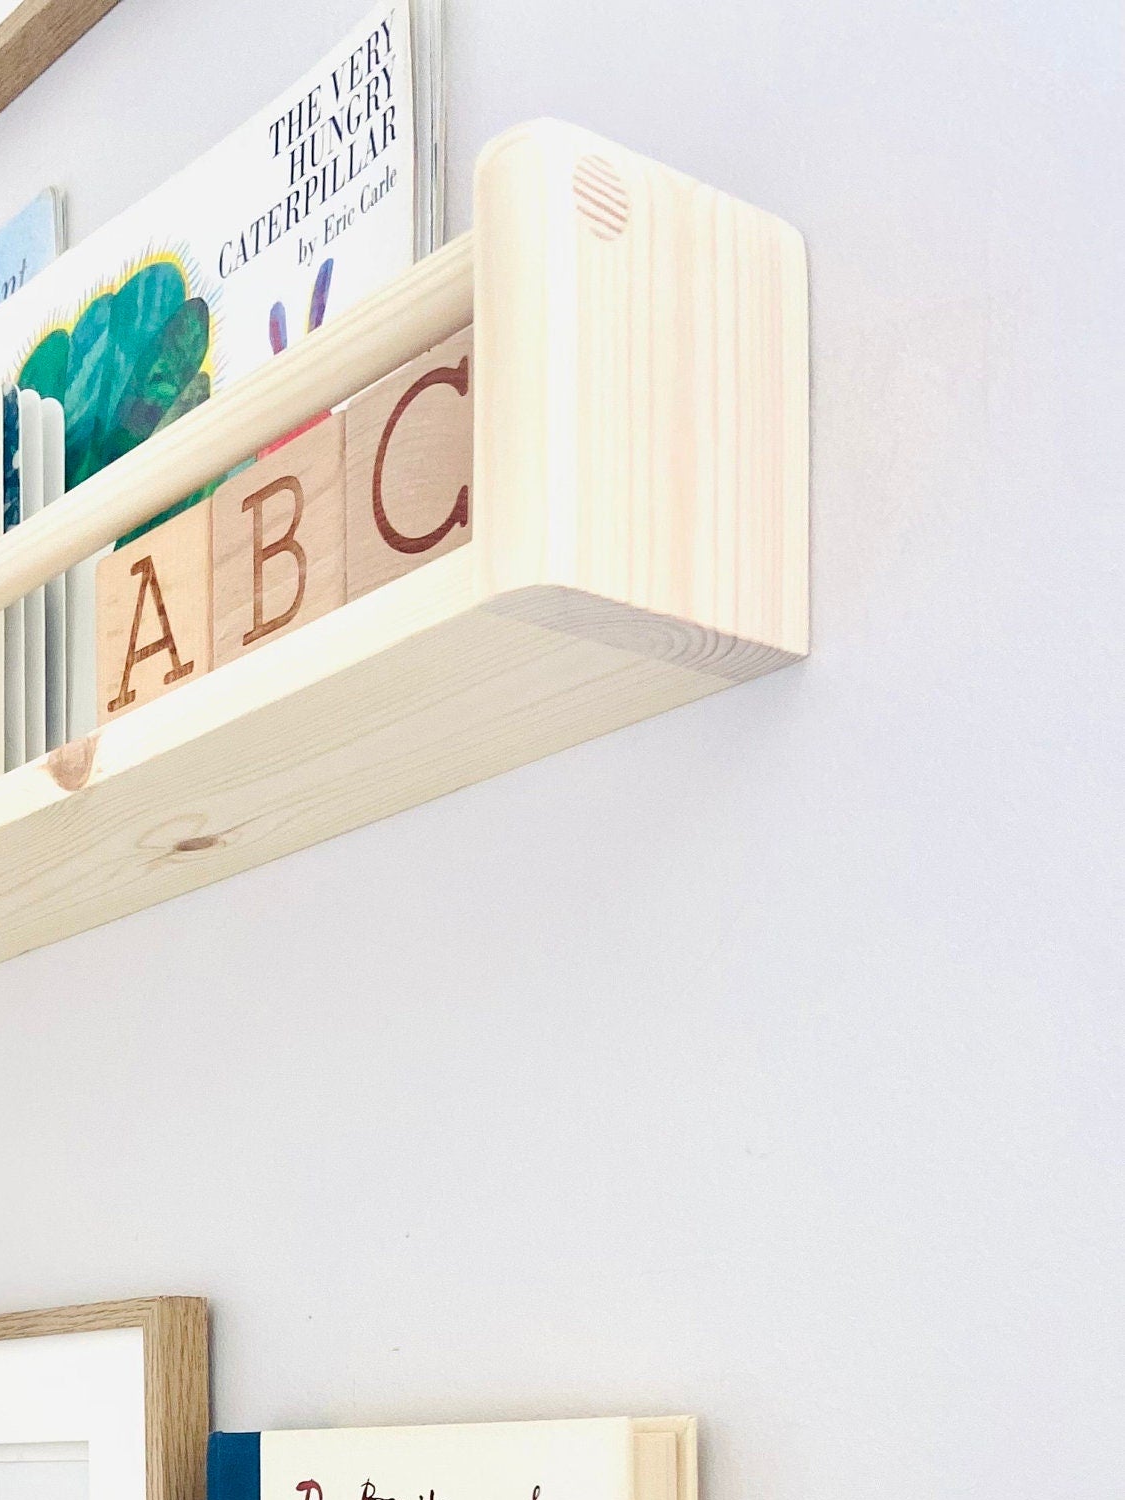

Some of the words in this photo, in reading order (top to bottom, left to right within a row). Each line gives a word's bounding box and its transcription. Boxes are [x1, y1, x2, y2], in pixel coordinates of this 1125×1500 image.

[269, 85, 322, 159] THE
[331, 8, 396, 104] VERY
[288, 53, 396, 188] HUNGRY
[218, 105, 397, 279] CATERPILLAR
[298, 237, 318, 267] by
[323, 204, 355, 247] Eric
[360, 164, 397, 214] Carle
[107, 554, 195, 713] A
[241, 475, 308, 647] B
[372, 355, 469, 554] C
